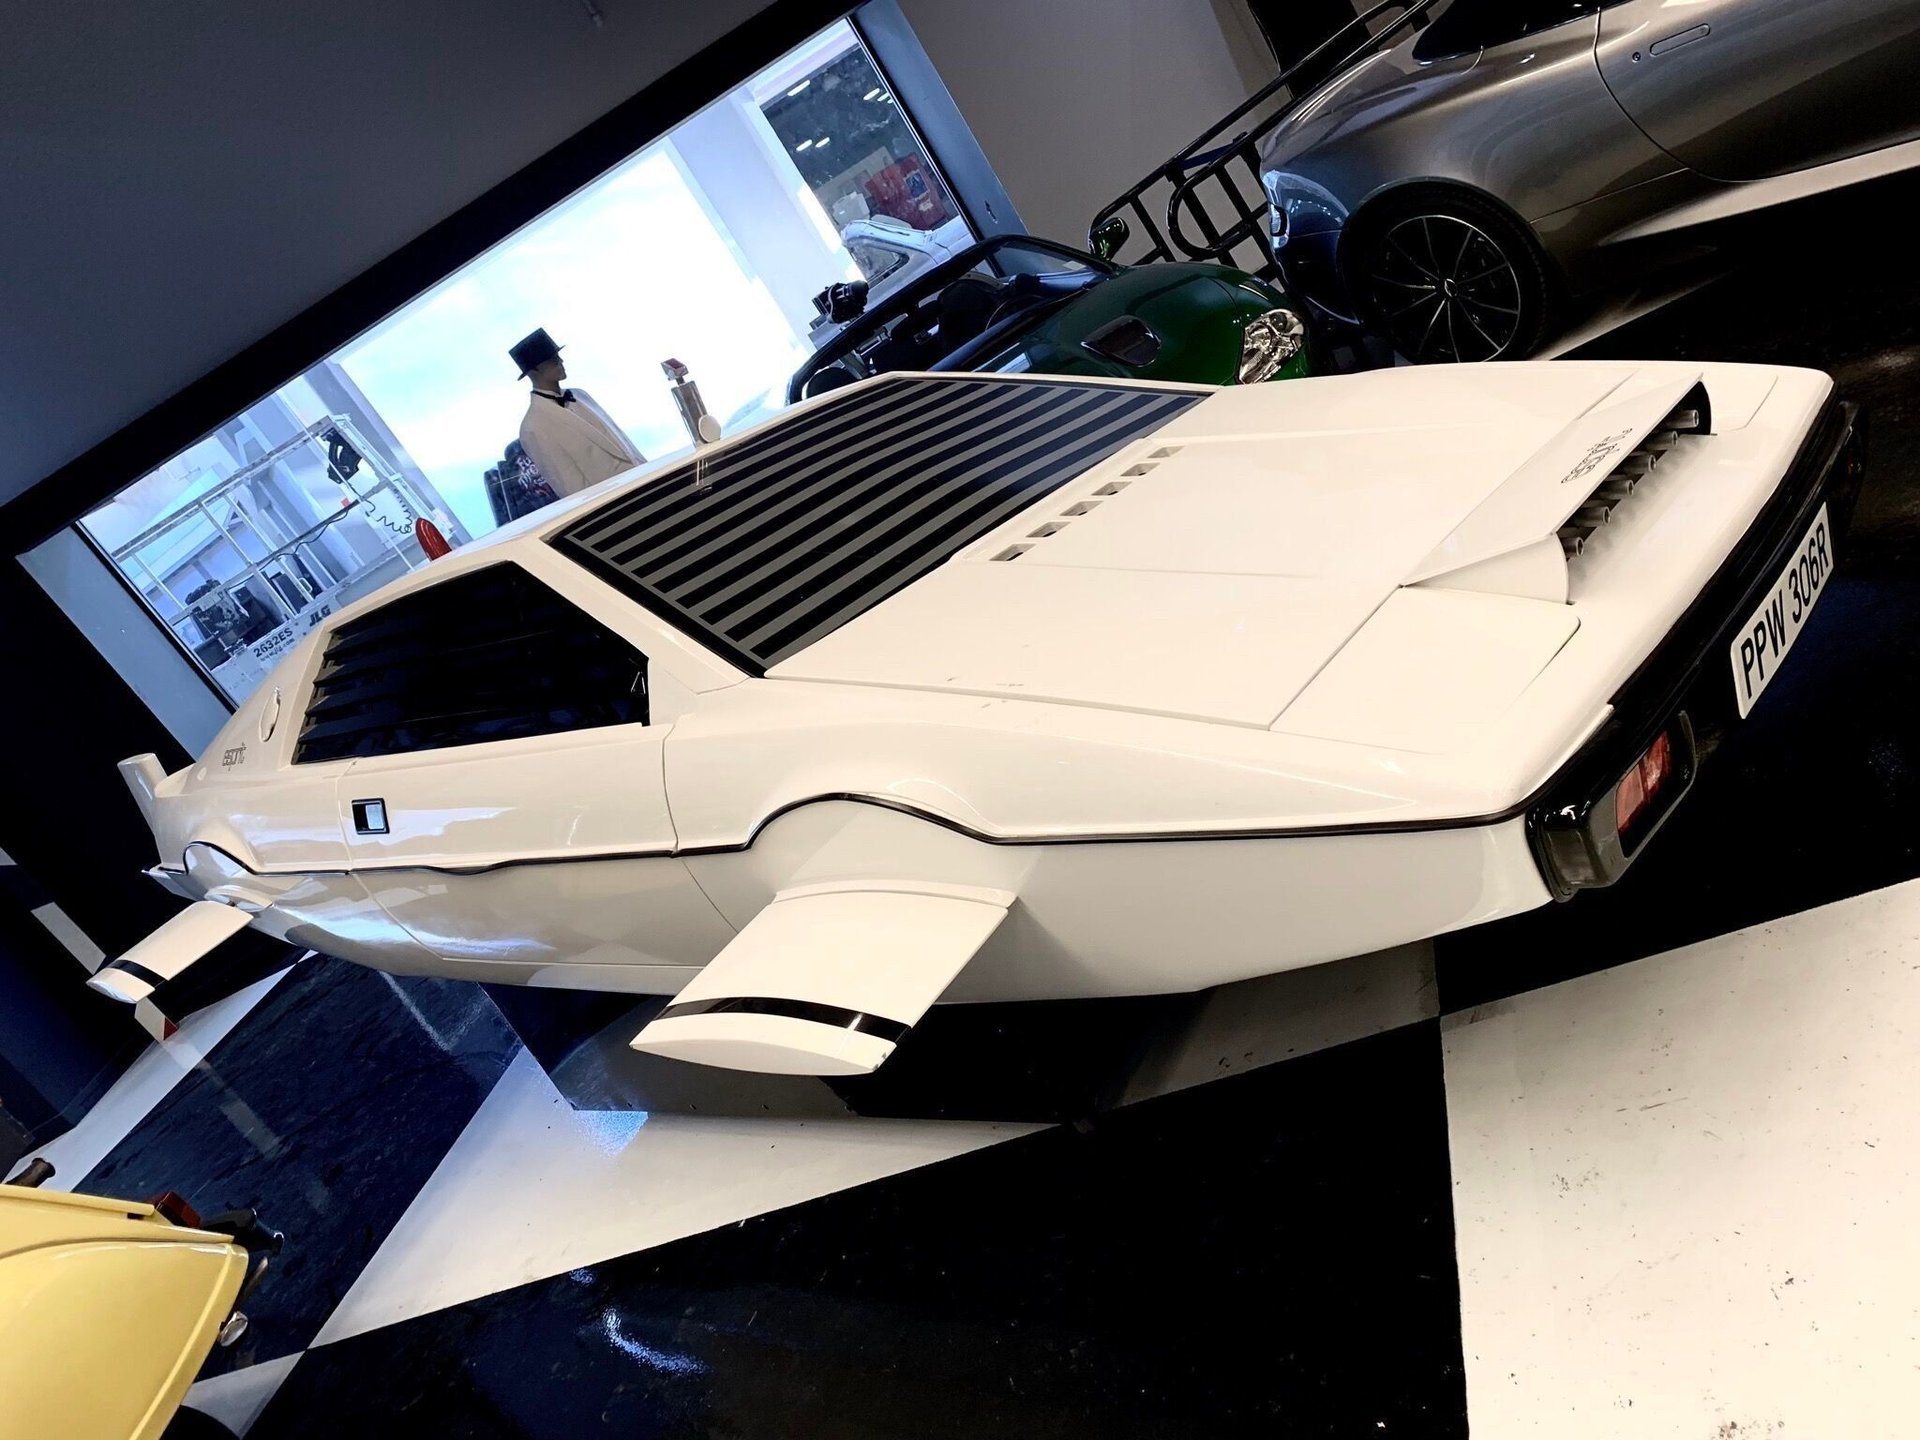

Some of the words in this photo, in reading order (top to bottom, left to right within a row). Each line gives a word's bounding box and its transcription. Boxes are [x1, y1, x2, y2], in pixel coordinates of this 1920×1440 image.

[309, 604, 331, 627] JLG
[1740, 589, 1786, 700] PPW
[1788, 522, 1829, 624] 306R
[253, 627, 293, 658] 2632ES
